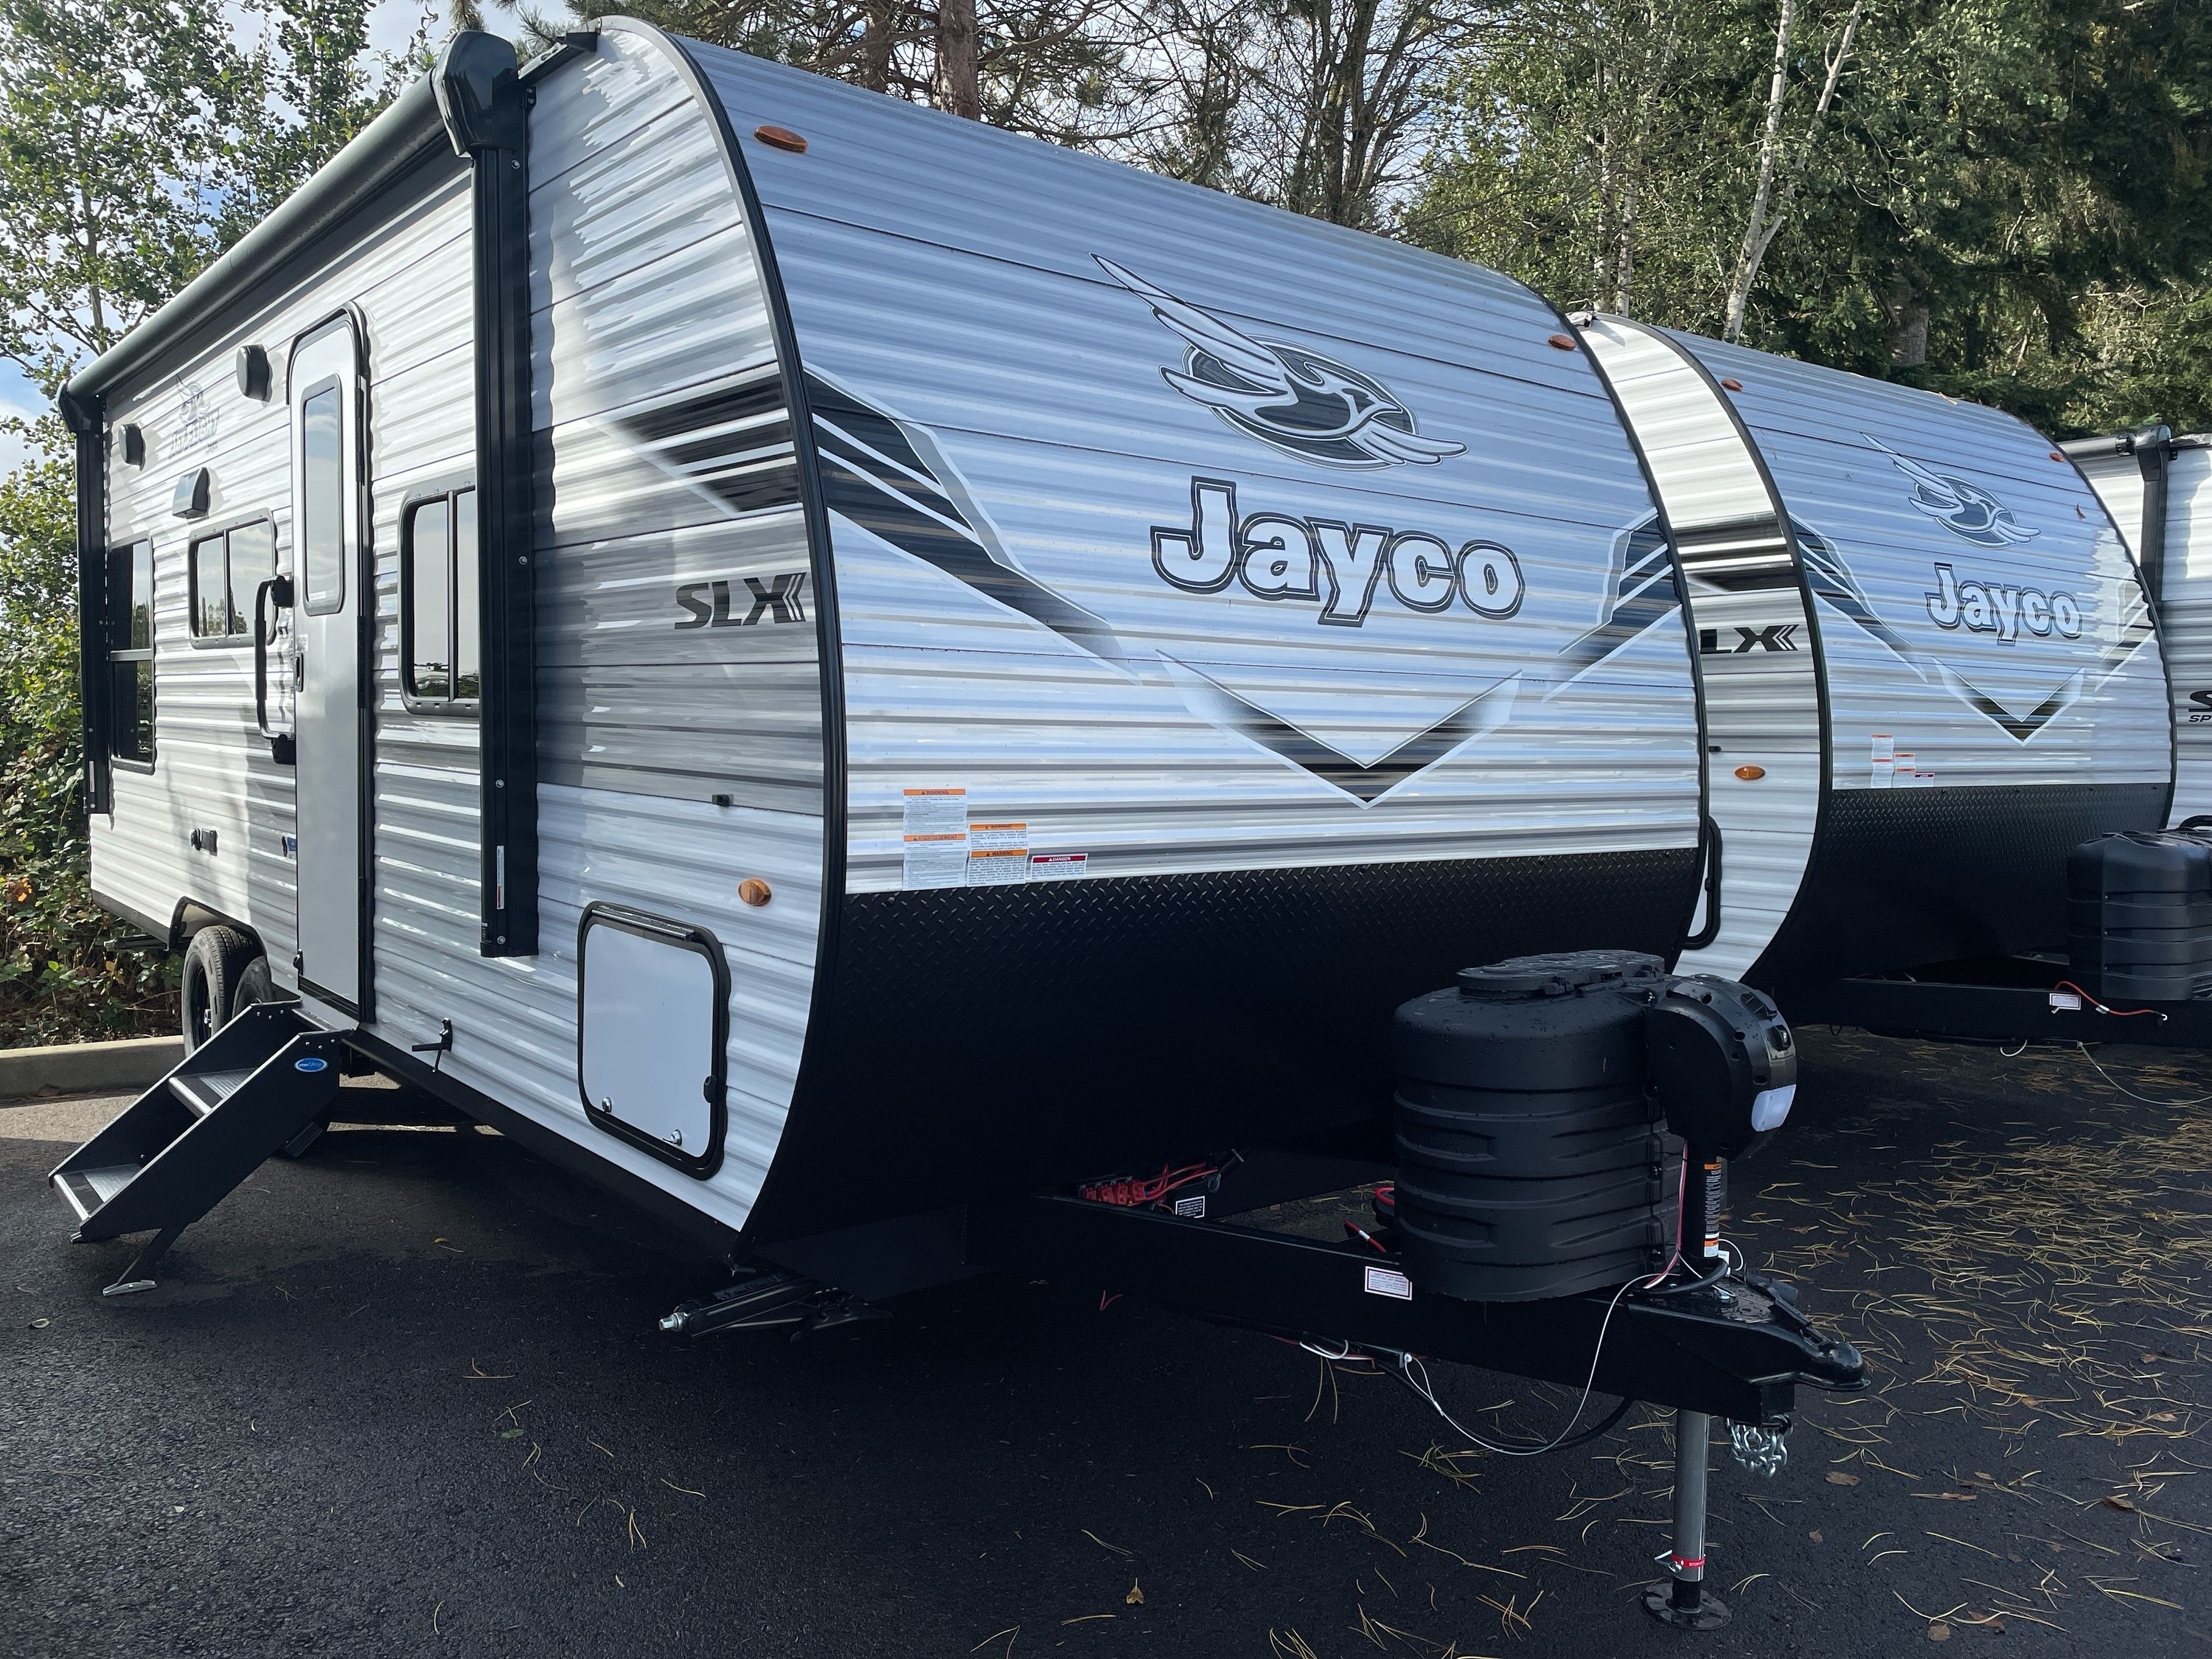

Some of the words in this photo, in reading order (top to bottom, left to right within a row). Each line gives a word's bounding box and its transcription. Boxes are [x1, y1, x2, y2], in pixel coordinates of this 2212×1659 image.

[1150, 476, 1526, 627] Jayco
[674, 571, 807, 630] SLX
[1924, 562, 2083, 647] Jayco
